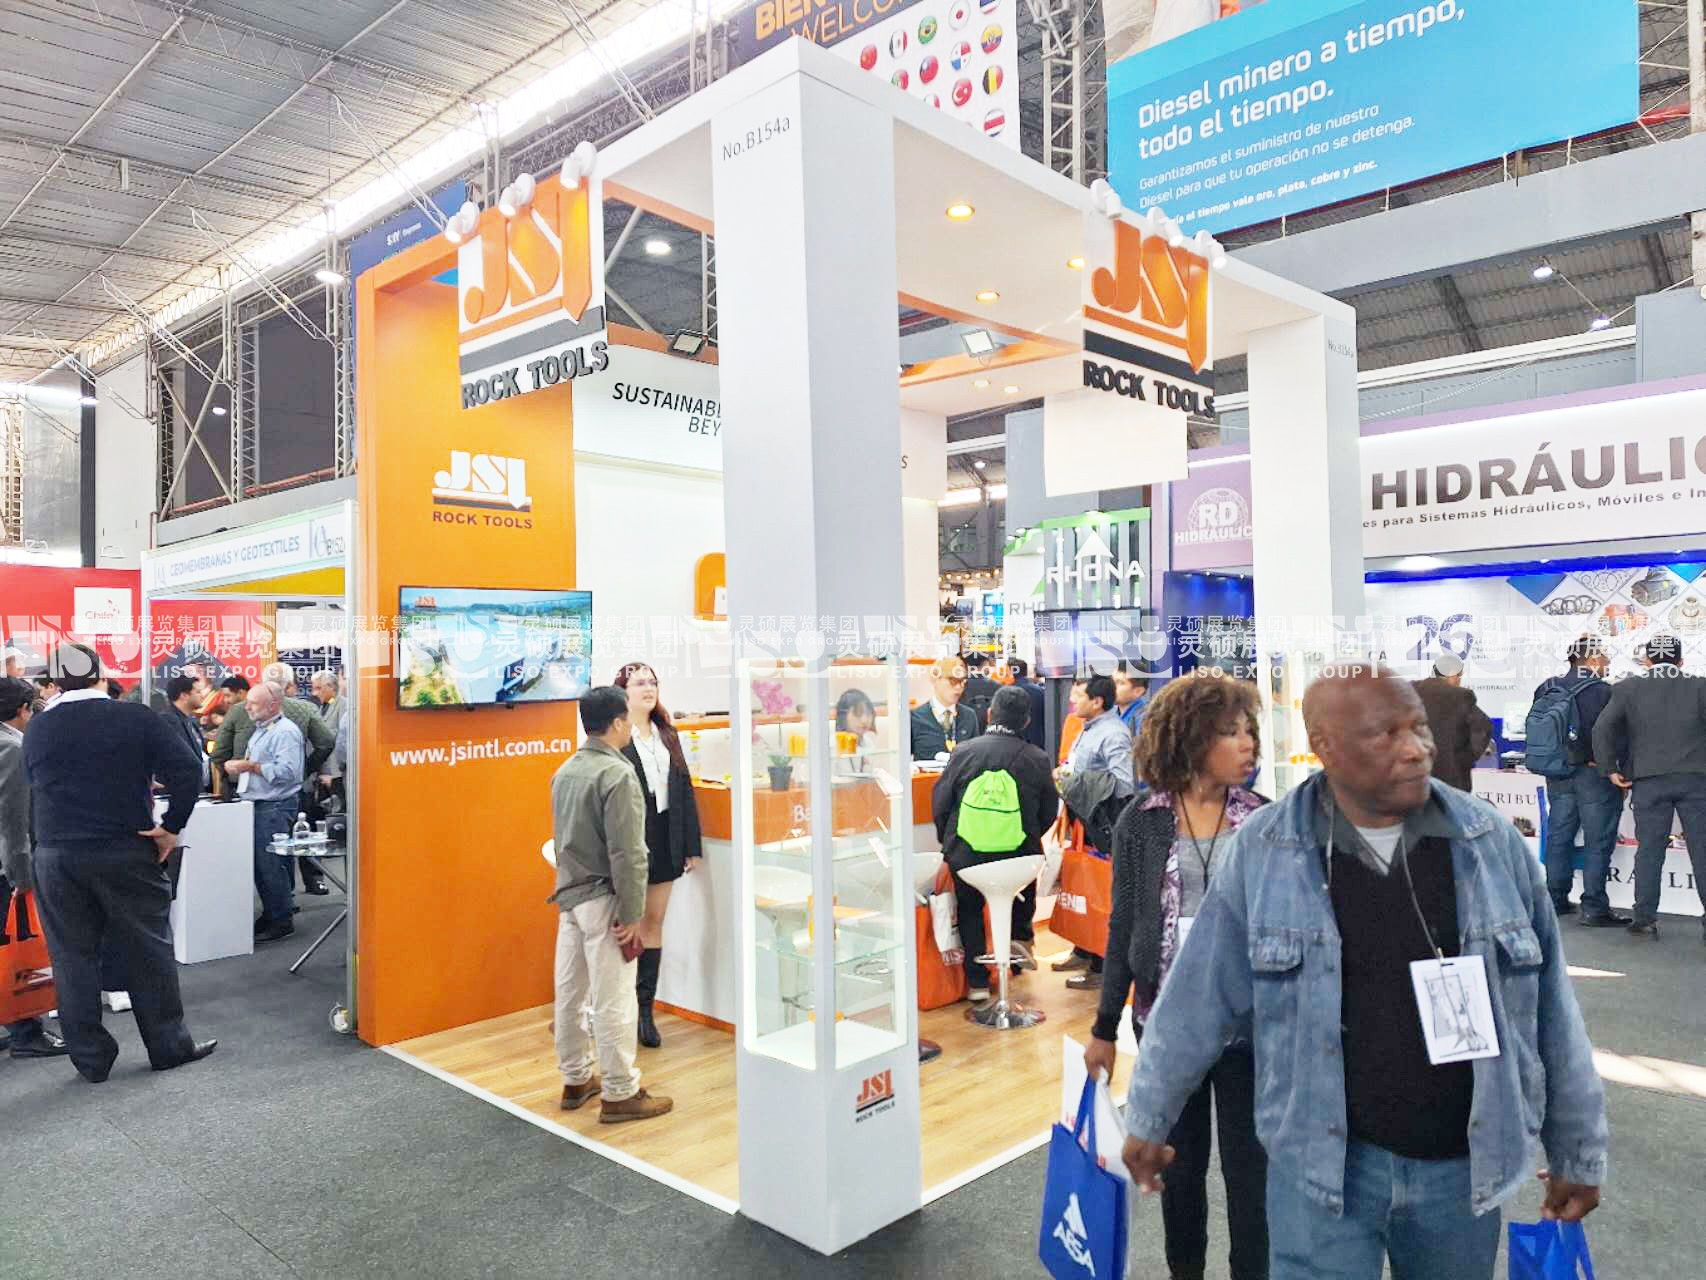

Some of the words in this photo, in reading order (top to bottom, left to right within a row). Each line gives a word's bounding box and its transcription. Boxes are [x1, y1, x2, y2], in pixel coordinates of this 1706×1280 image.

[1139, 80, 1212, 129] Diesel
[1219, 49, 1312, 99] minero
[1320, 40, 1337, 63] a
[1344, 0, 1465, 54] tiempo,
[723, 117, 790, 161] No.B154a
[1138, 124, 1193, 159] todo
[1200, 109, 1224, 138] el
[1231, 79, 1334, 127] tiempo.
[1139, 156, 1217, 190] Garantizamos
[1221, 149, 1232, 164] el
[1235, 129, 1301, 159] suministro
[1306, 122, 1322, 137] de
[1325, 104, 1380, 131] nuestro
[1139, 187, 1173, 209] Diesel
[1176, 180, 1202, 200] para
[1204, 172, 1227, 189] que
[1229, 167, 1243, 181] tu
[1245, 147, 1309, 178] operación
[1312, 140, 1329, 156] no
[1333, 135, 1349, 150] se
[1352, 114, 1416, 144] detenga.
[1197, 202, 1231, 218] tiempo
[462, 367, 521, 410] ROCK
[527, 340, 609, 389] TOOLS
[1083, 360, 1146, 401] ROCK
[1154, 380, 1216, 418] TOOLS
[1371, 435, 1706, 510] HIDRÁULI
[433, 511, 477, 526] ROCK
[483, 515, 532, 529] TOOLS
[1199, 501, 1239, 528] RD
[1383, 516, 1414, 528] para
[1419, 508, 1487, 523] Sistemas
[1493, 501, 1591, 517] Hidráulicos,
[1598, 491, 1664, 507] Móviles
[1672, 491, 1682, 501] e
[240, 536, 300, 560] GEOTEXTILES
[390, 738, 571, 767] www.jsintl.com.cn
